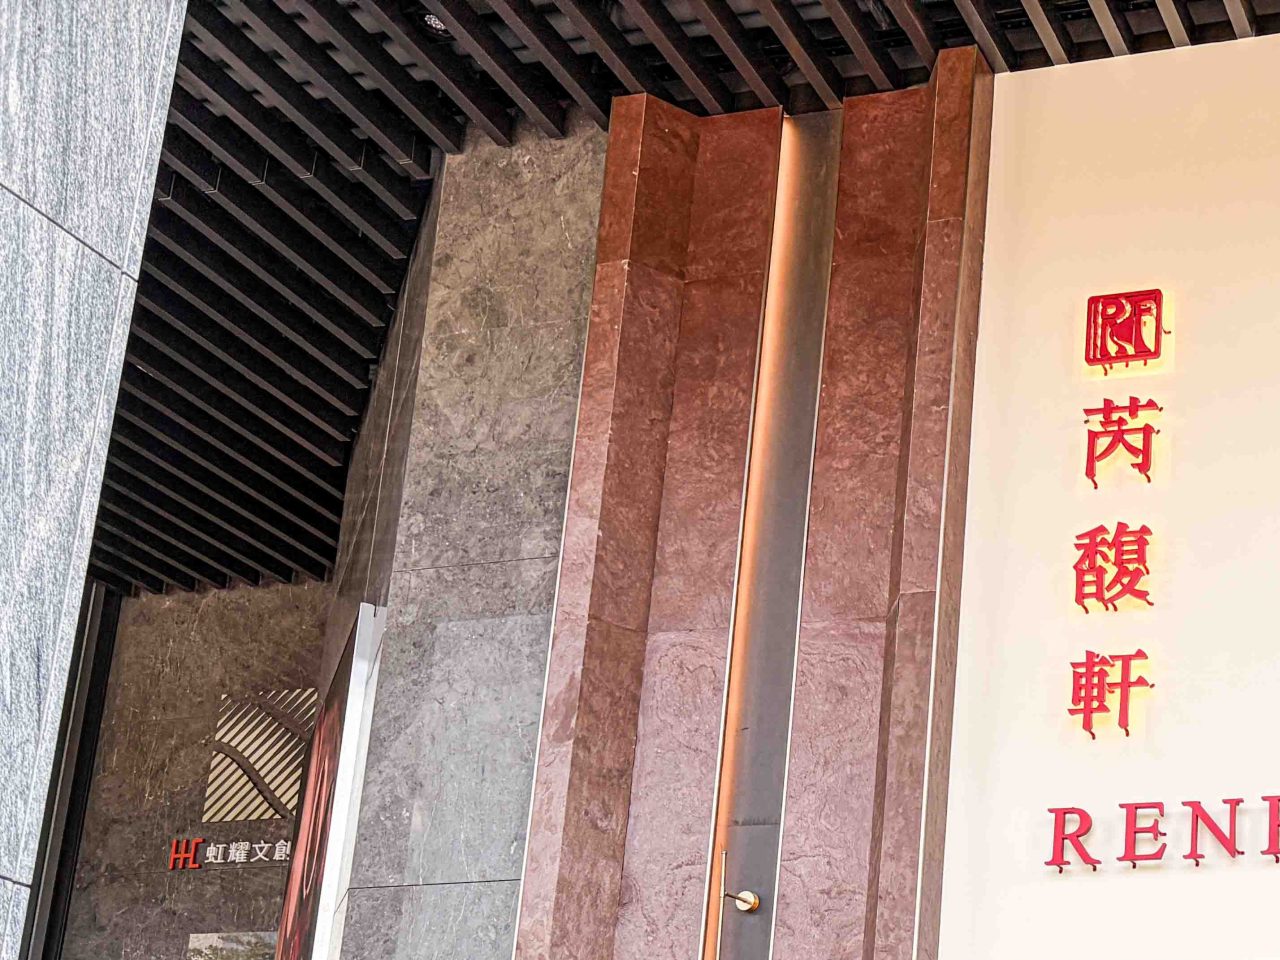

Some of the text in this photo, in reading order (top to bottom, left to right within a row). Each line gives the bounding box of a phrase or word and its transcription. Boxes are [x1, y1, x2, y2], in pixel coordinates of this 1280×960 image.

[1067, 396, 1163, 737] 芮馥軒
[204, 840, 292, 864] 虹耀文創
